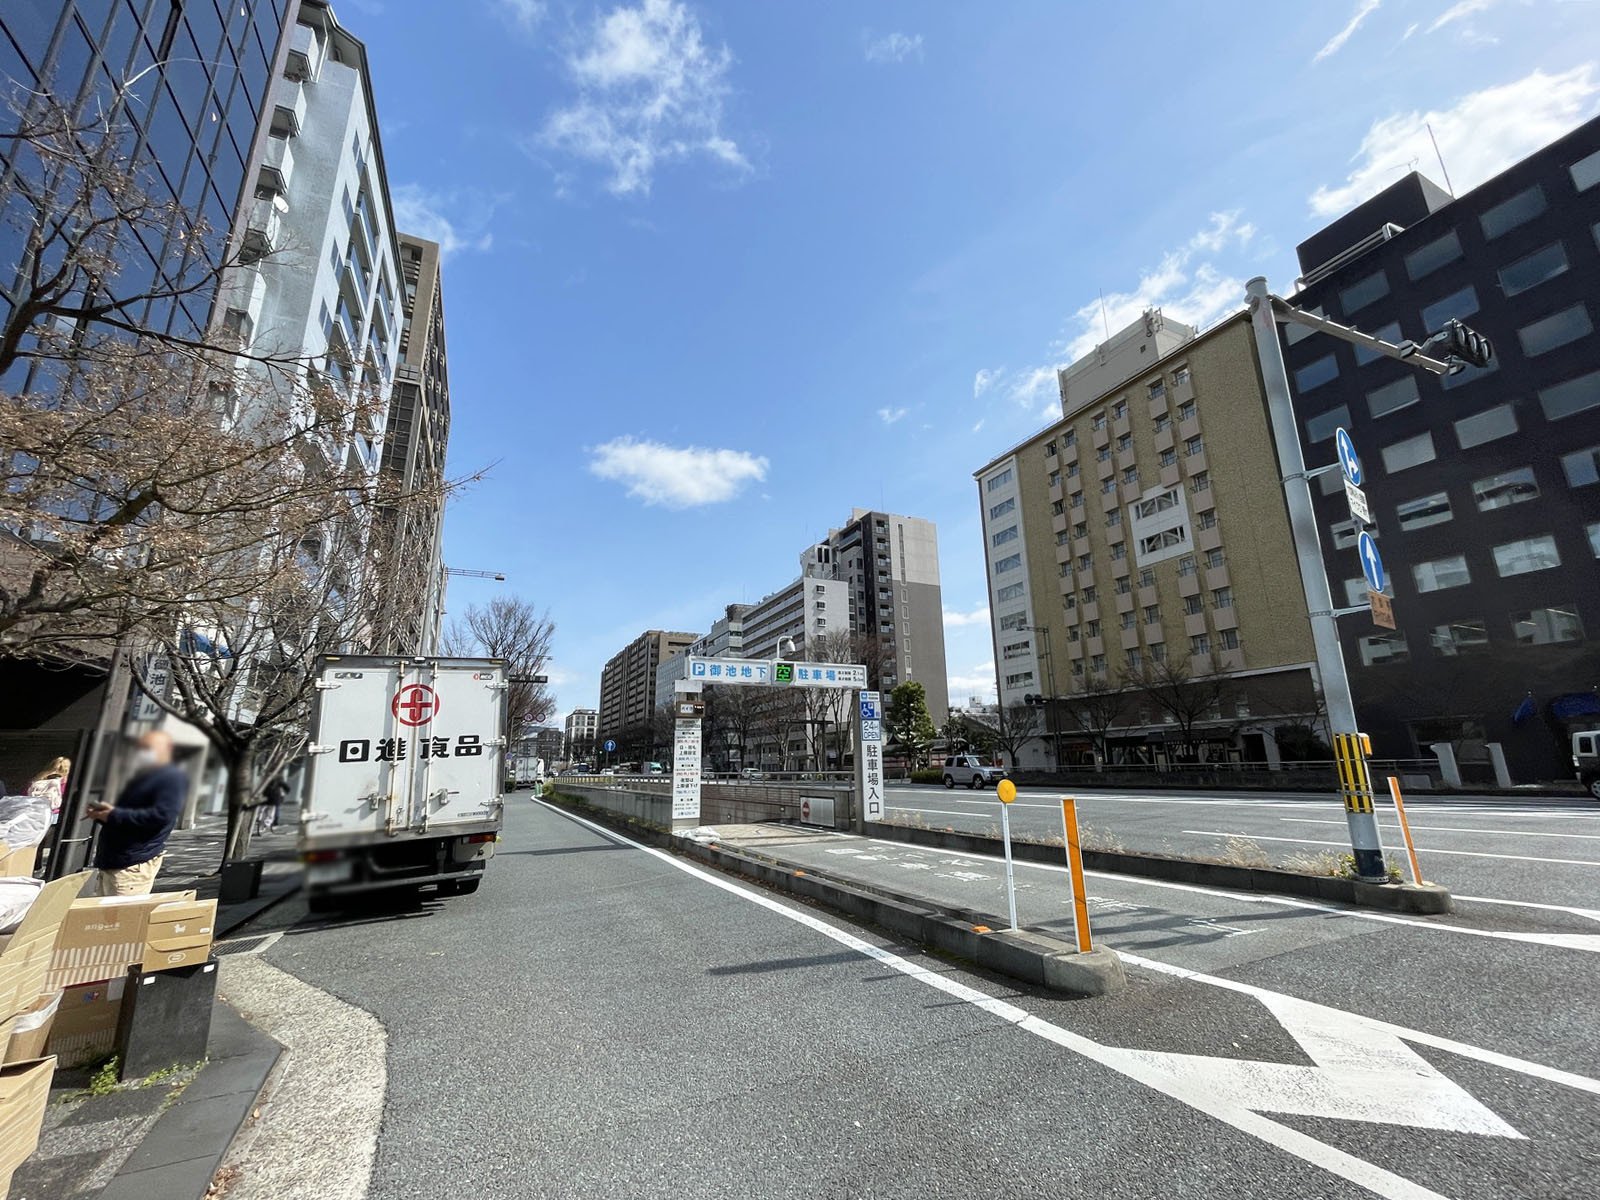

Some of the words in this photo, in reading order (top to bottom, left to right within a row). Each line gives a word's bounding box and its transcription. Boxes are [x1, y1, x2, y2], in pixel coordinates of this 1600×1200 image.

[710, 664, 767, 678] 御池地下
[776, 665, 791, 682] 空
[798, 669, 836, 681] 駐車場
[339, 735, 483, 763] 日進食品
[866, 744, 880, 814] 駐車場入口
